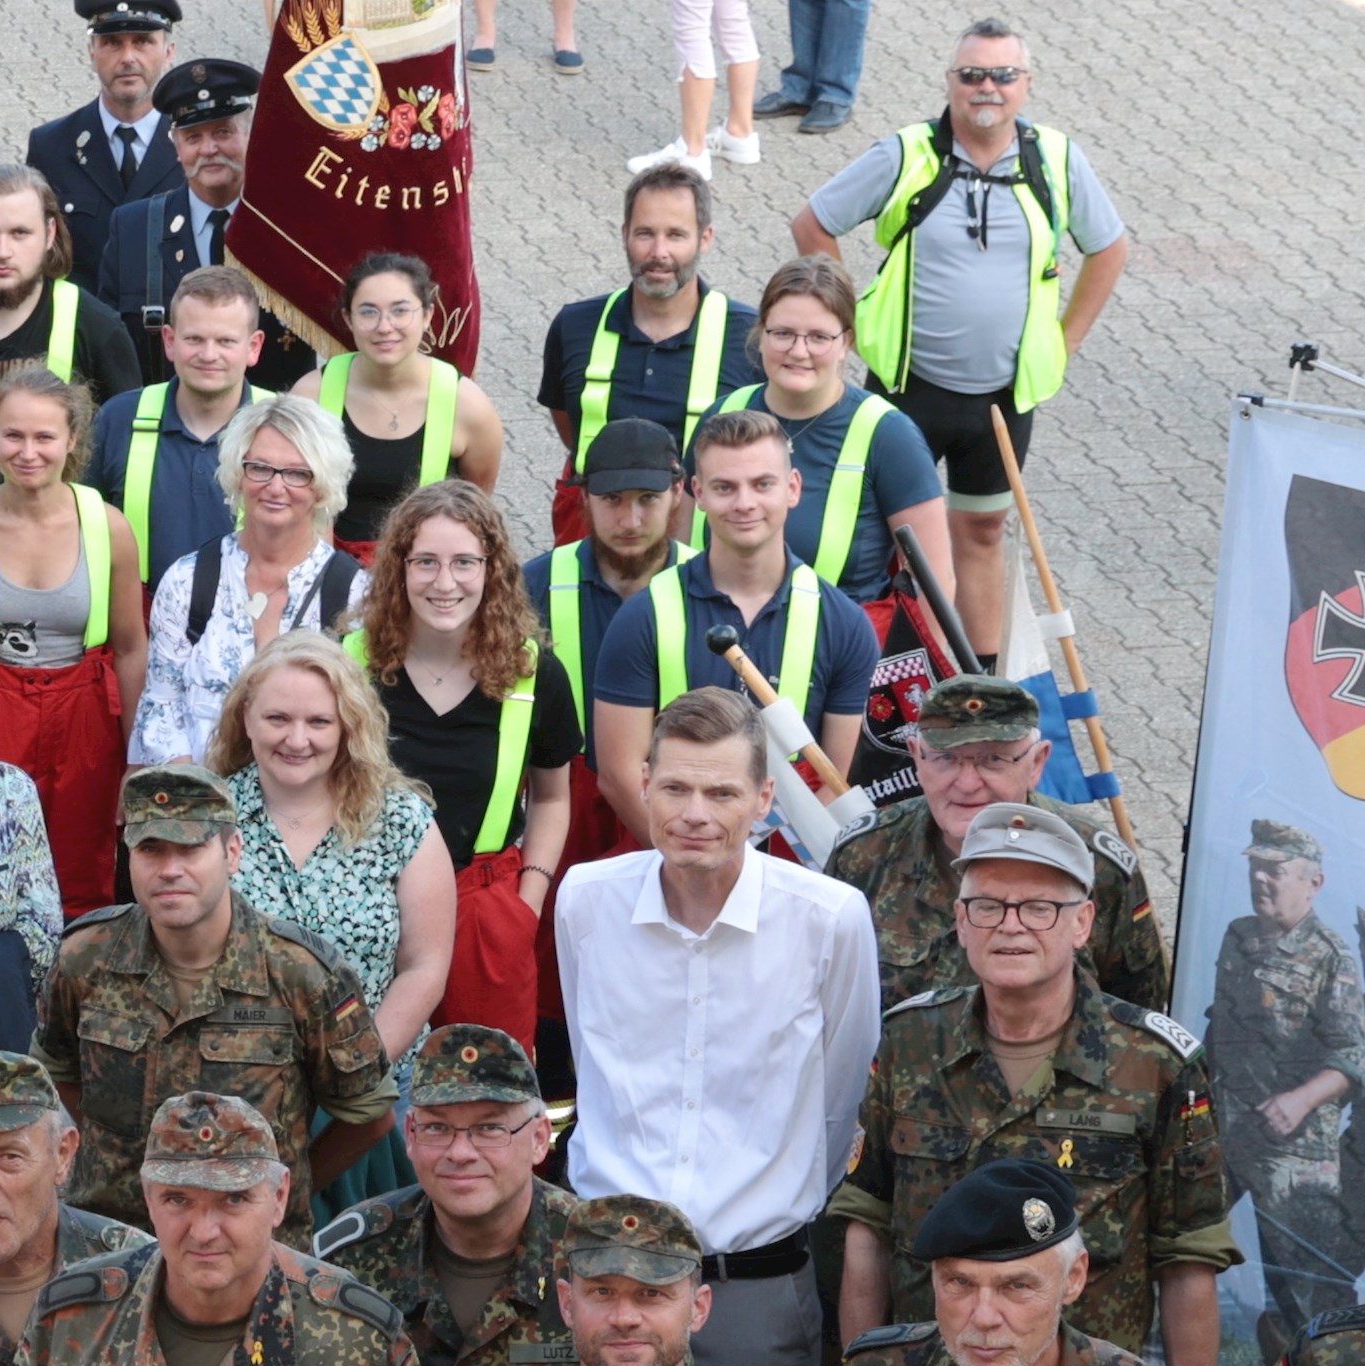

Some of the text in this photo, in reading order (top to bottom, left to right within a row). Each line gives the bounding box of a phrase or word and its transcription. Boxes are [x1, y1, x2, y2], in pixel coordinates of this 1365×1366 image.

[233, 1010, 267, 1021] MAIER
[1069, 1113, 1102, 1127] LANG
[543, 1346, 575, 1359] LUTZ
